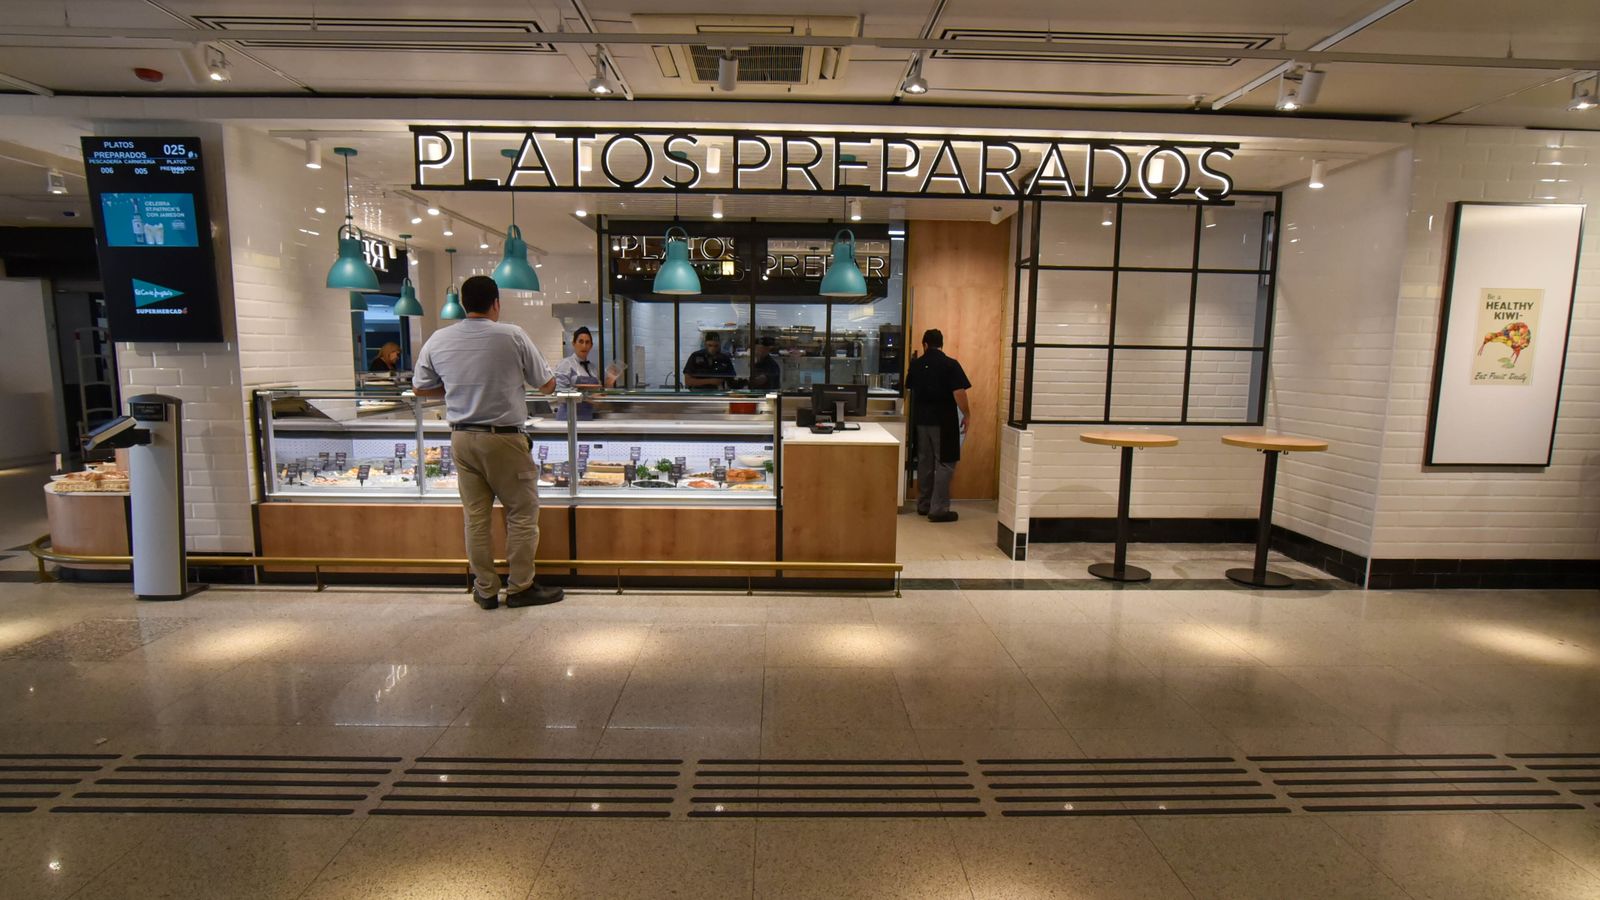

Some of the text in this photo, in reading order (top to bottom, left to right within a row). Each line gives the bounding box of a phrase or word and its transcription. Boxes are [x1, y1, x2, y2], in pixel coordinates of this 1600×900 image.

[103, 141, 134, 149] PLATOS
[163, 144, 186, 155] 025
[93, 151, 147, 159] PREPARADOS
[413, 131, 1234, 200] PLATOS PREPARADOS
[134, 167, 148, 175] 005
[1485, 301, 1534, 310] HEALTHY
